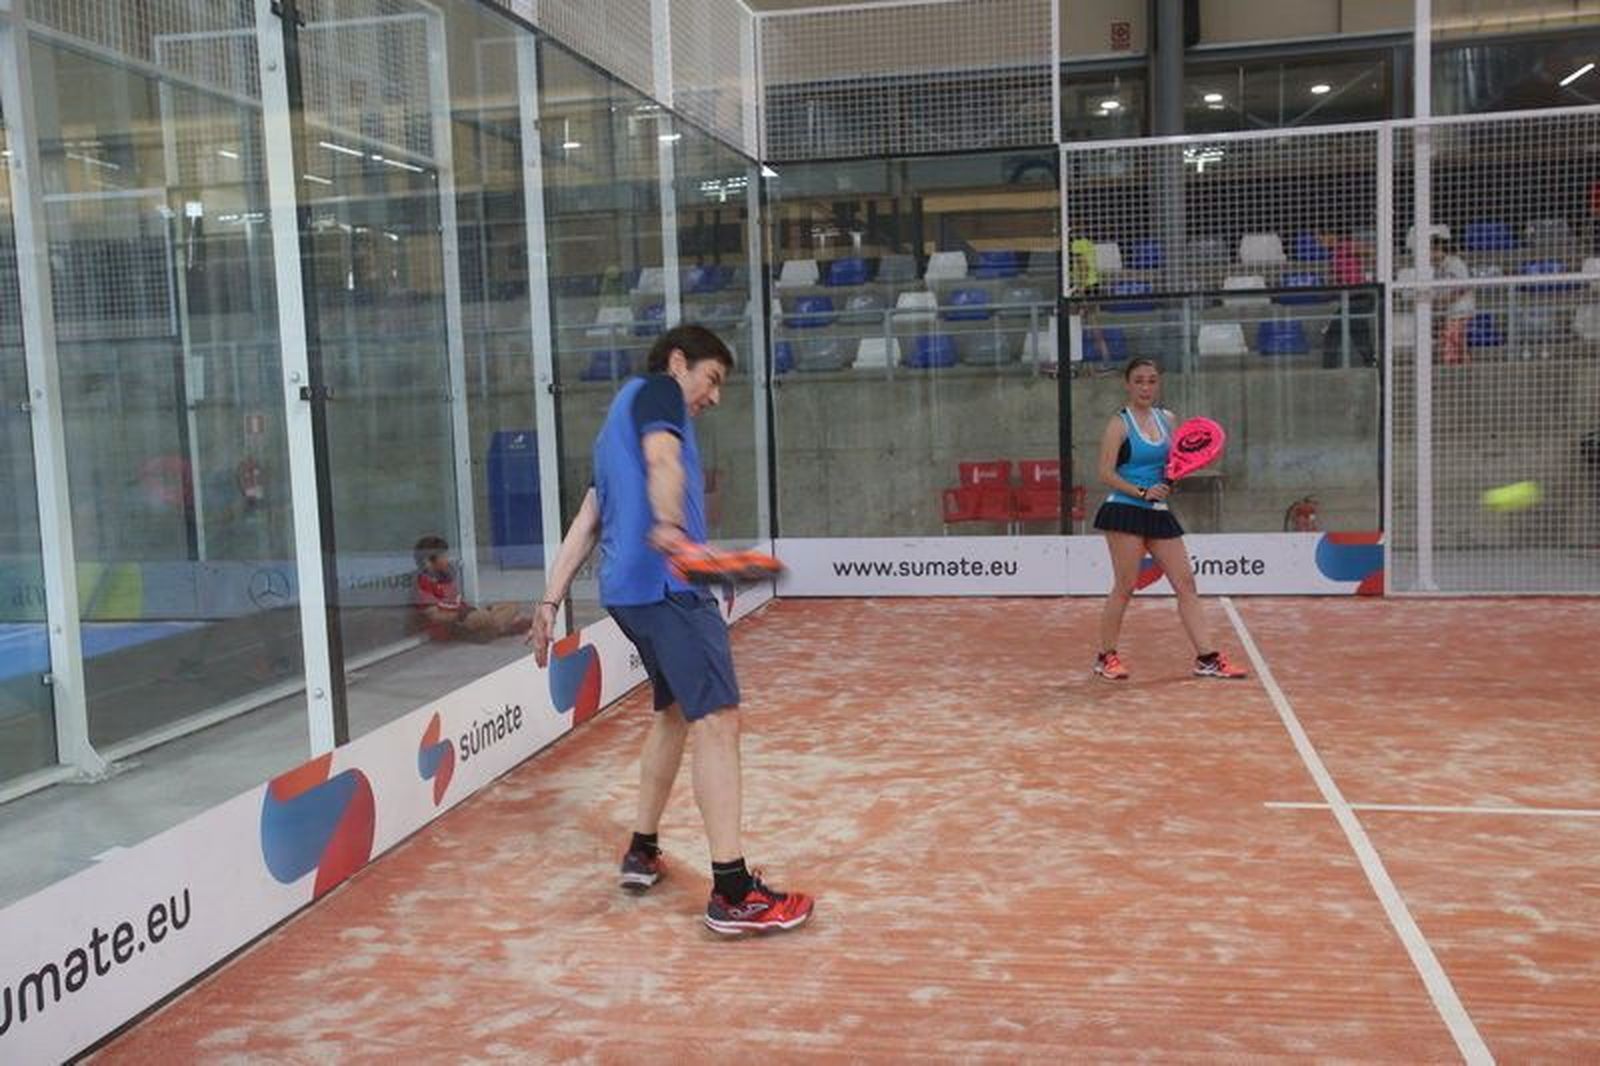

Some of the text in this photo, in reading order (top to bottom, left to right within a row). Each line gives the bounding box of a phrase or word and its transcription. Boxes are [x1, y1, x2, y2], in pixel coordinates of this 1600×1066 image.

[833, 558, 1018, 577] www.sumate.eu
[1192, 555, 1265, 576] úmate
[460, 704, 522, 762] súmate
